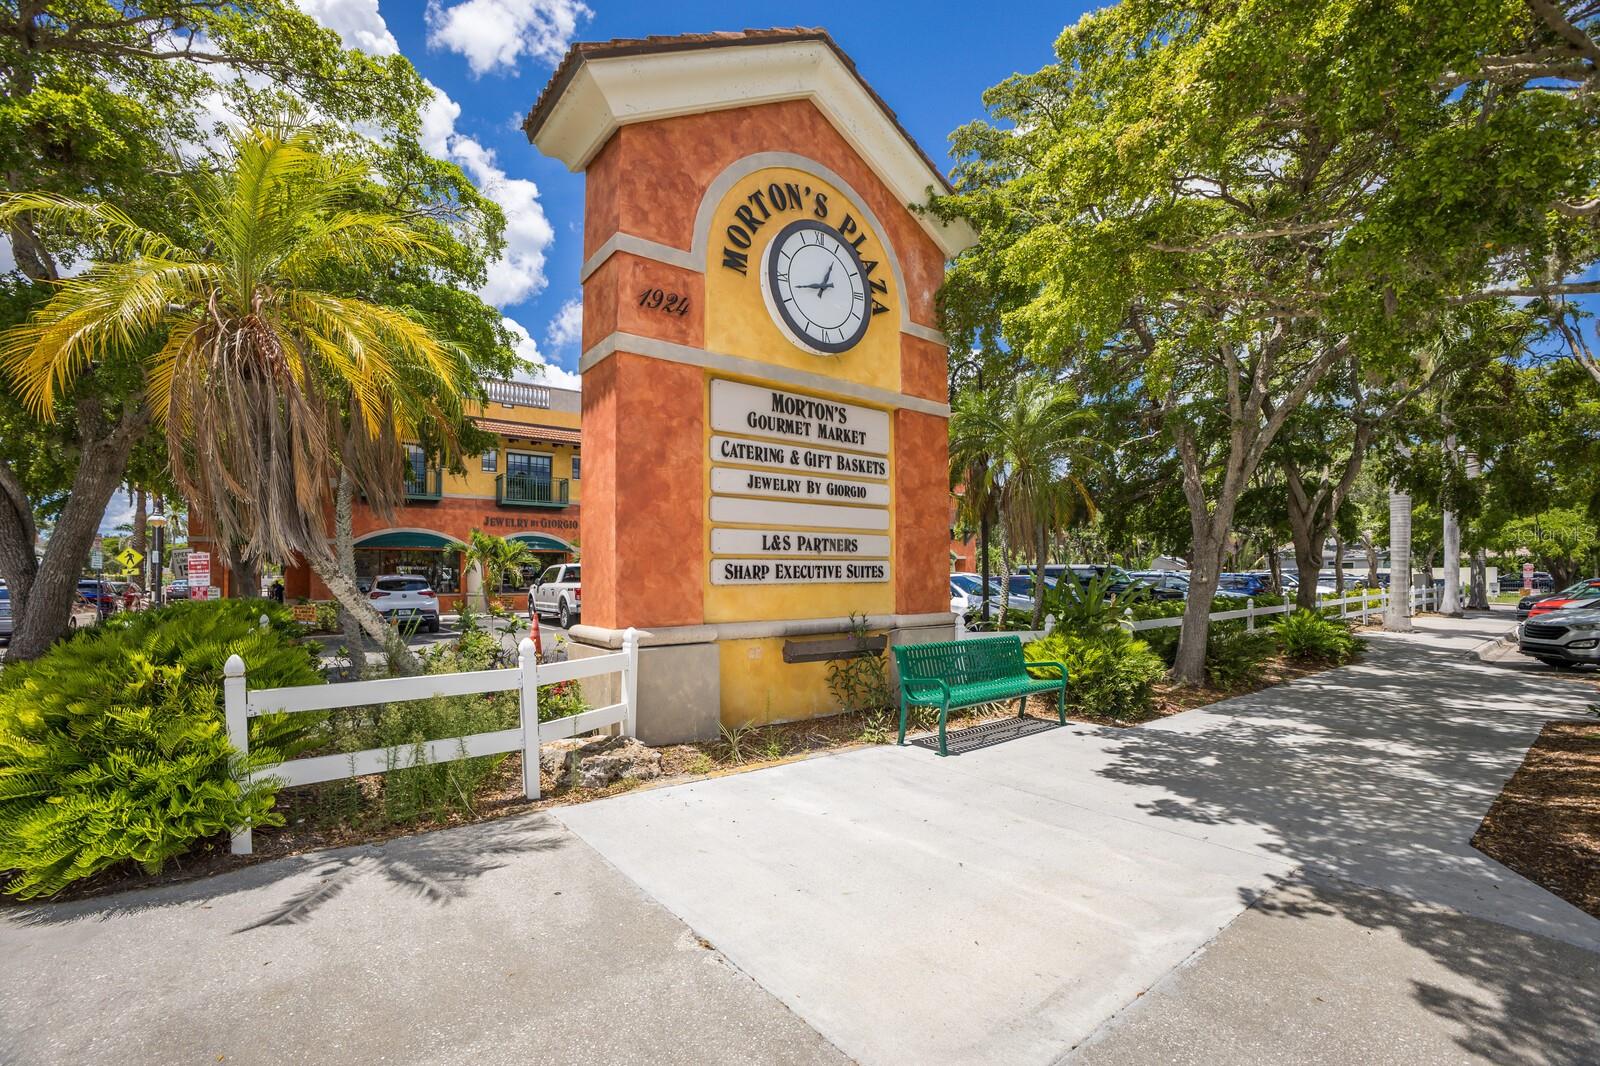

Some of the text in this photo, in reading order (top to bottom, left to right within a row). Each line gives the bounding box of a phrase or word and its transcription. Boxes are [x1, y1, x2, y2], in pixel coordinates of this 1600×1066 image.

[723, 183, 890, 316] MORTON'S PLAZA
[638, 287, 690, 316] 1924
[771, 392, 847, 424] MORTON'S
[747, 411, 866, 445] GOURMET MARKET
[720, 440, 886, 475] CATERING & GIFT BASKETS
[747, 475, 800, 493] JEWELRY
[826, 482, 867, 499] GIORGIO
[484, 517, 528, 528] JEWELRY
[540, 520, 578, 529] GIORGIO
[762, 535, 858, 553] L&S PARTNERS
[724, 563, 884, 580] SHARP EXECUTIVE SUITES
